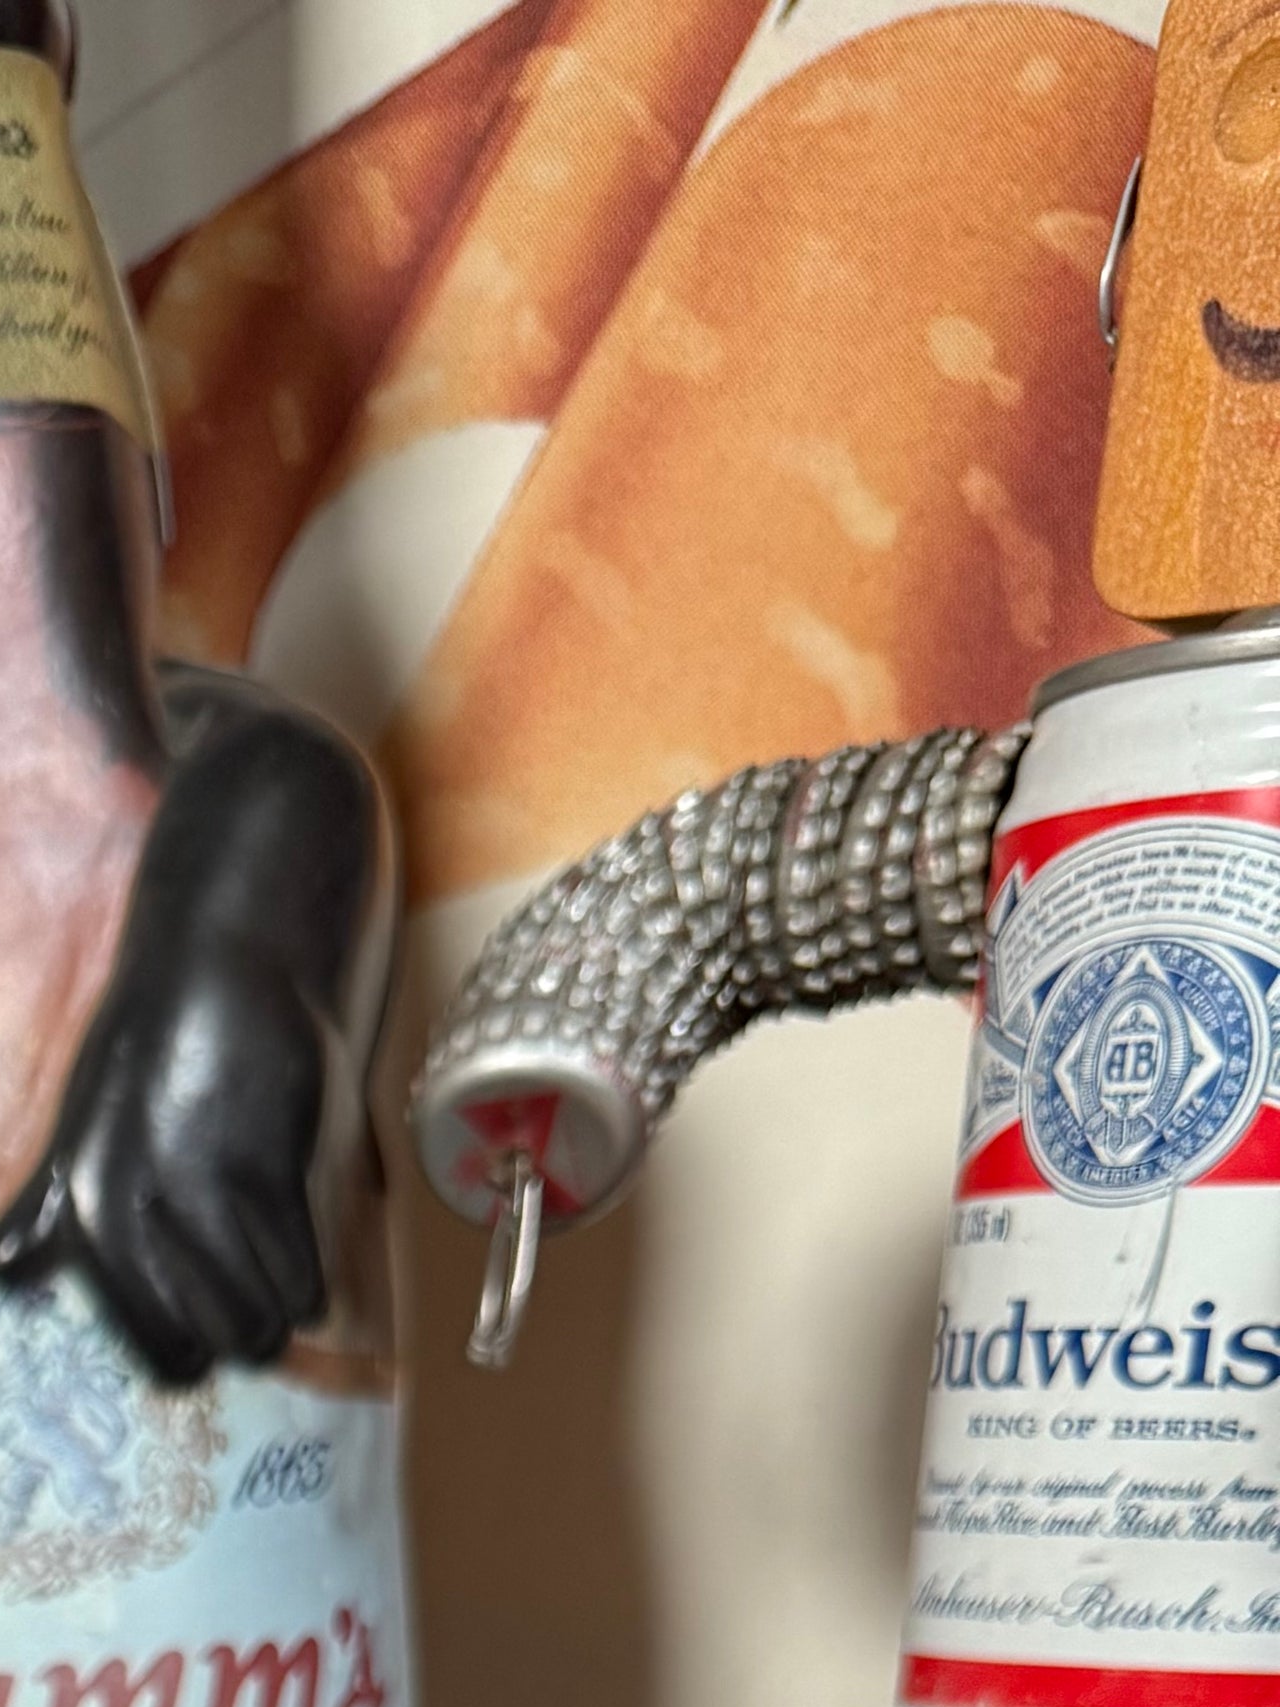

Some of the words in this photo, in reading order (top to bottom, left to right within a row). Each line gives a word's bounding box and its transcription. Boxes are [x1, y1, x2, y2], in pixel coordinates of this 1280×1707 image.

[1106, 1042, 1156, 1084] AB
[966, 1413, 1037, 1440] KING
[1049, 1414, 1096, 1440] OF
